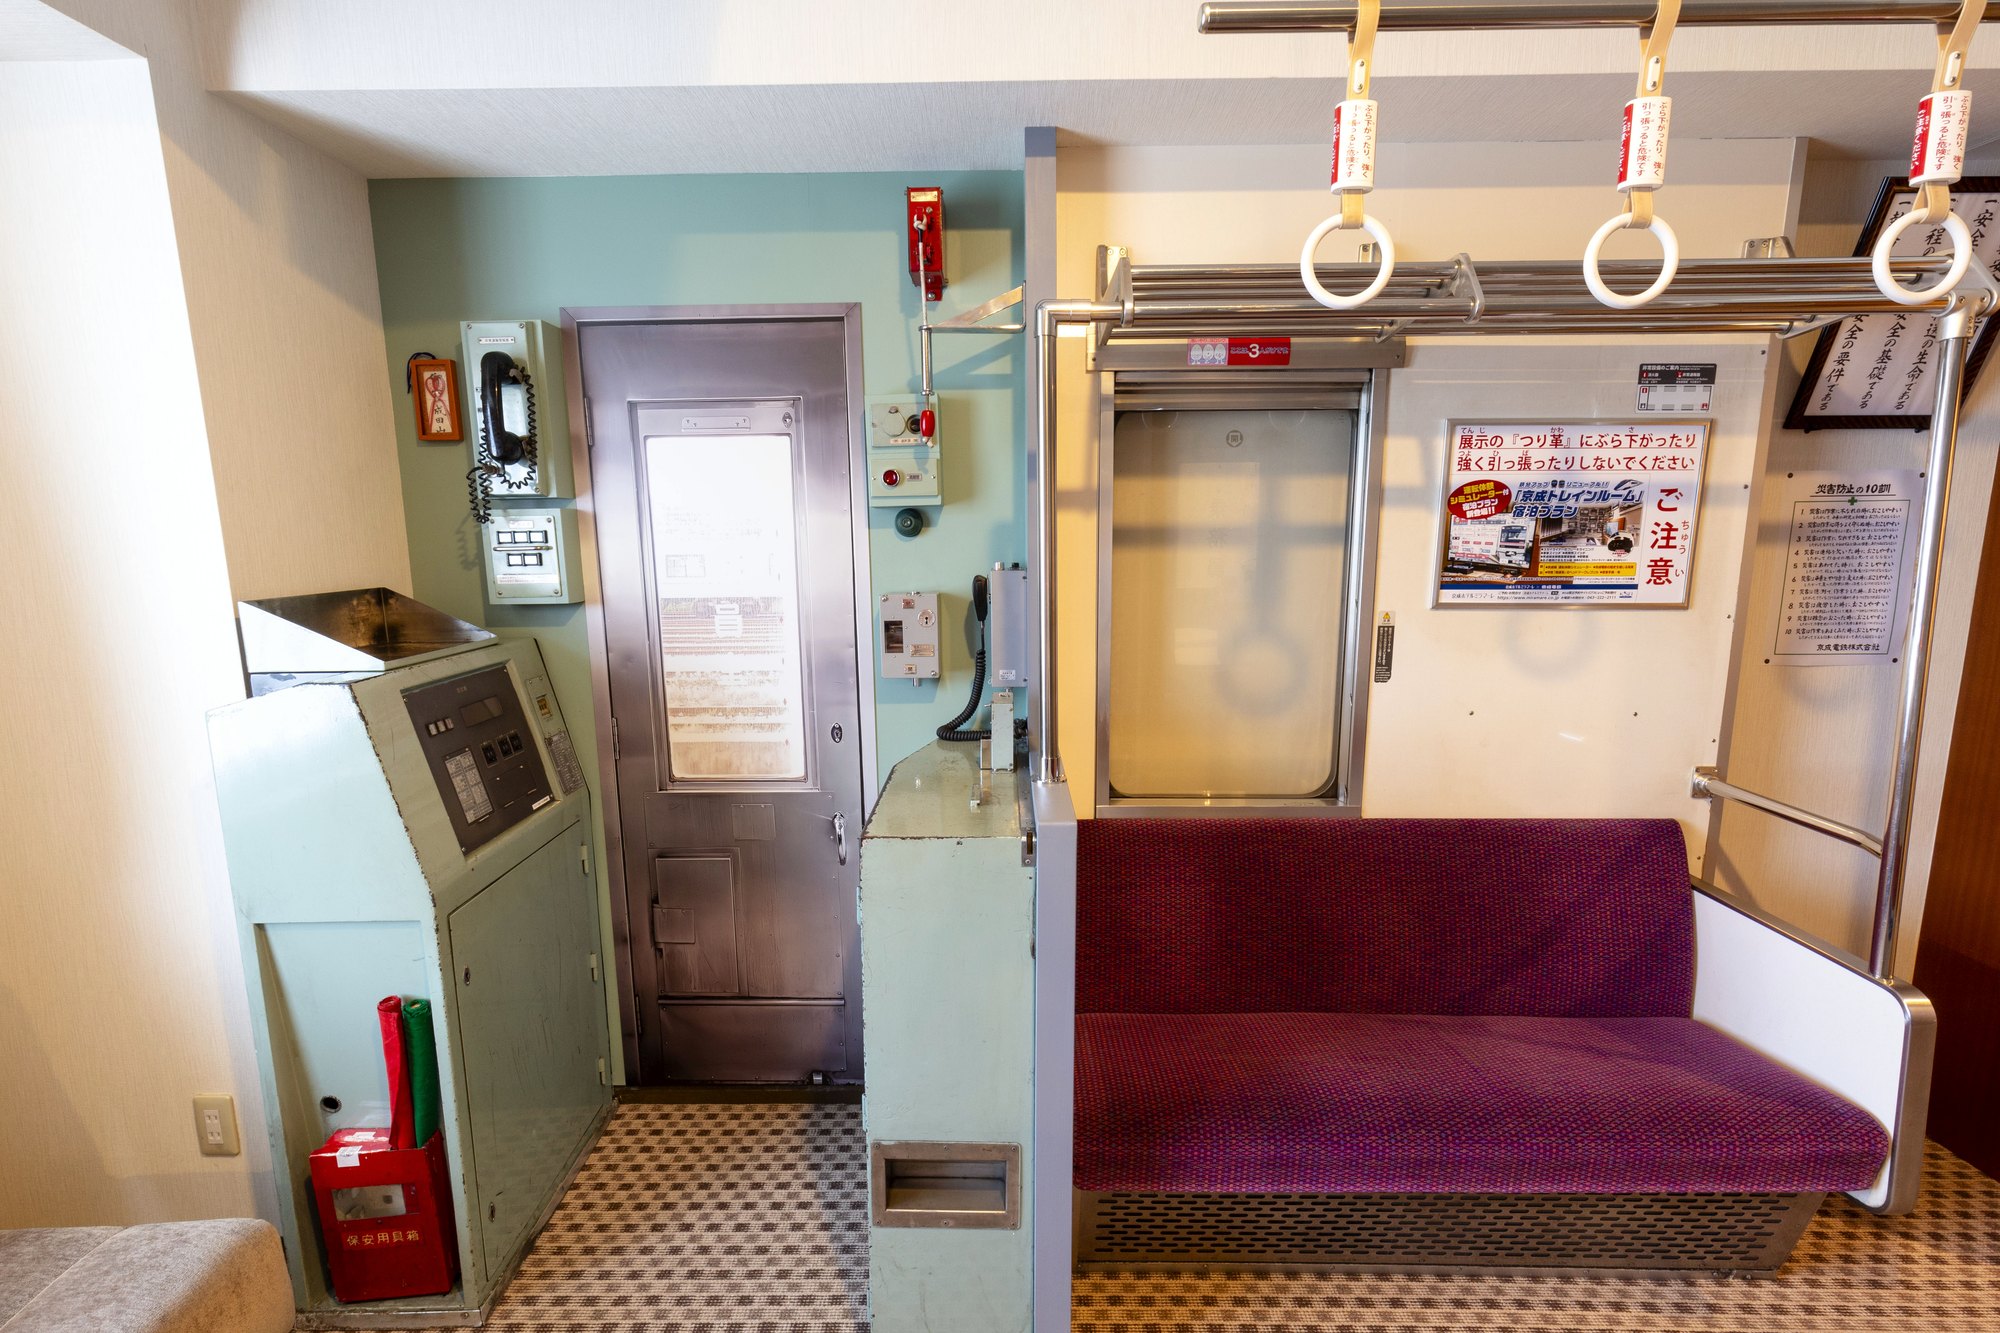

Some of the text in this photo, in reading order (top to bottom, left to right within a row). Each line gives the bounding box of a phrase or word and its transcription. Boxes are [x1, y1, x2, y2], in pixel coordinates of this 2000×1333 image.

[1458, 433, 1696, 449] 展示の『つり革』にぶら下がったり
[1457, 455, 1695, 471] 強く引っ張ったりしないでください
[1514, 489, 1645, 503] 「京成トレインルーム」
[1815, 484, 1891, 494] 災害防止の10訓
[1512, 505, 1578, 518] 宿泊プラン
[1646, 488, 1684, 585] ご注意
[1816, 643, 1880, 652] 京成電鉄株式会社
[346, 1230, 419, 1246] 保安用具箱
